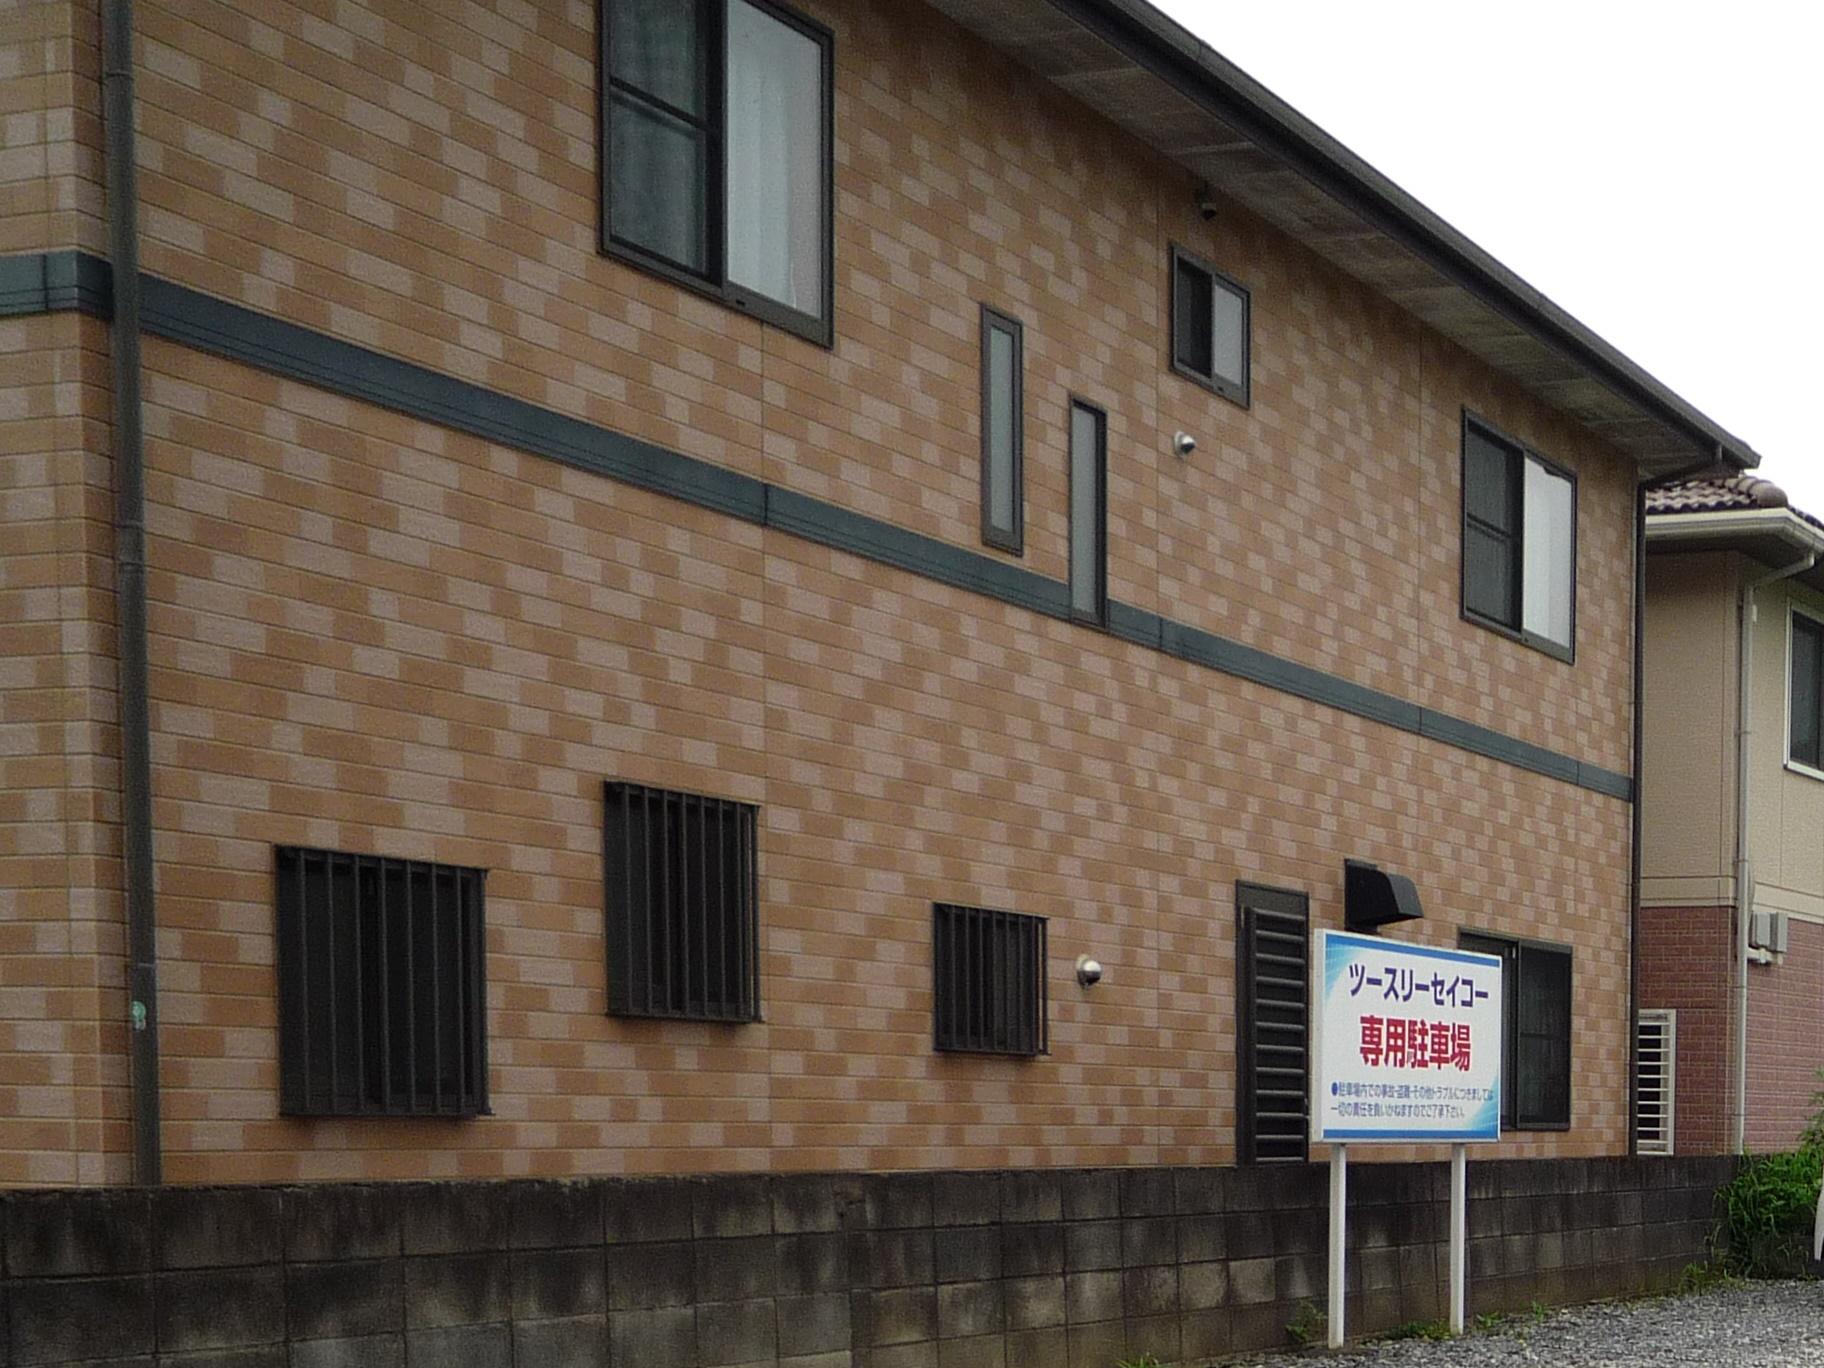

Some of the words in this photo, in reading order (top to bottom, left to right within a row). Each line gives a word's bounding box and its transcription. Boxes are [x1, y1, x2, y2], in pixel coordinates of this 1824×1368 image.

[1349, 963, 1489, 1008] ツースリーセイコー
[1360, 1015, 1472, 1072] 専用駐車場
